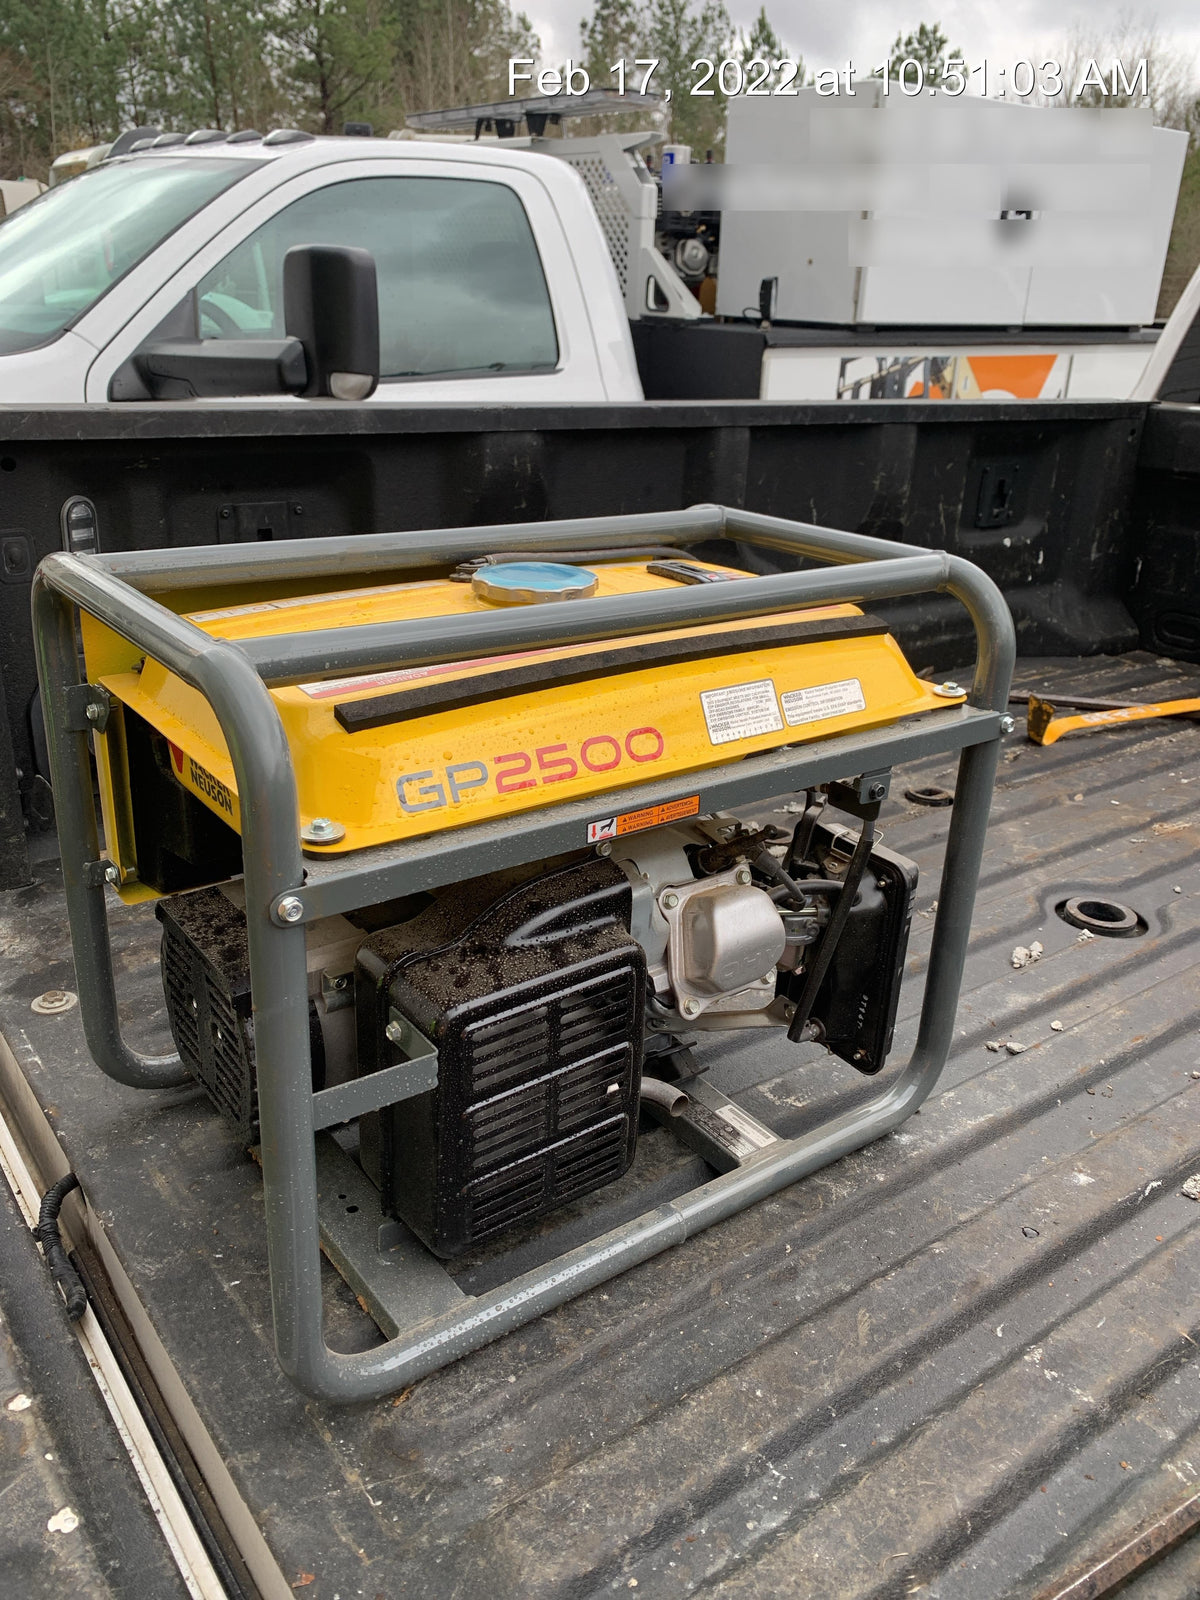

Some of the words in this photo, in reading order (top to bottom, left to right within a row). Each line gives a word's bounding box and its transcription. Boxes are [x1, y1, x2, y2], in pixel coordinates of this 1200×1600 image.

[395, 726, 664, 813] GP2500
[190, 766, 233, 817] NEUSON
[628, 810, 654, 821] WARNING
[628, 820, 653, 830] WARNING
